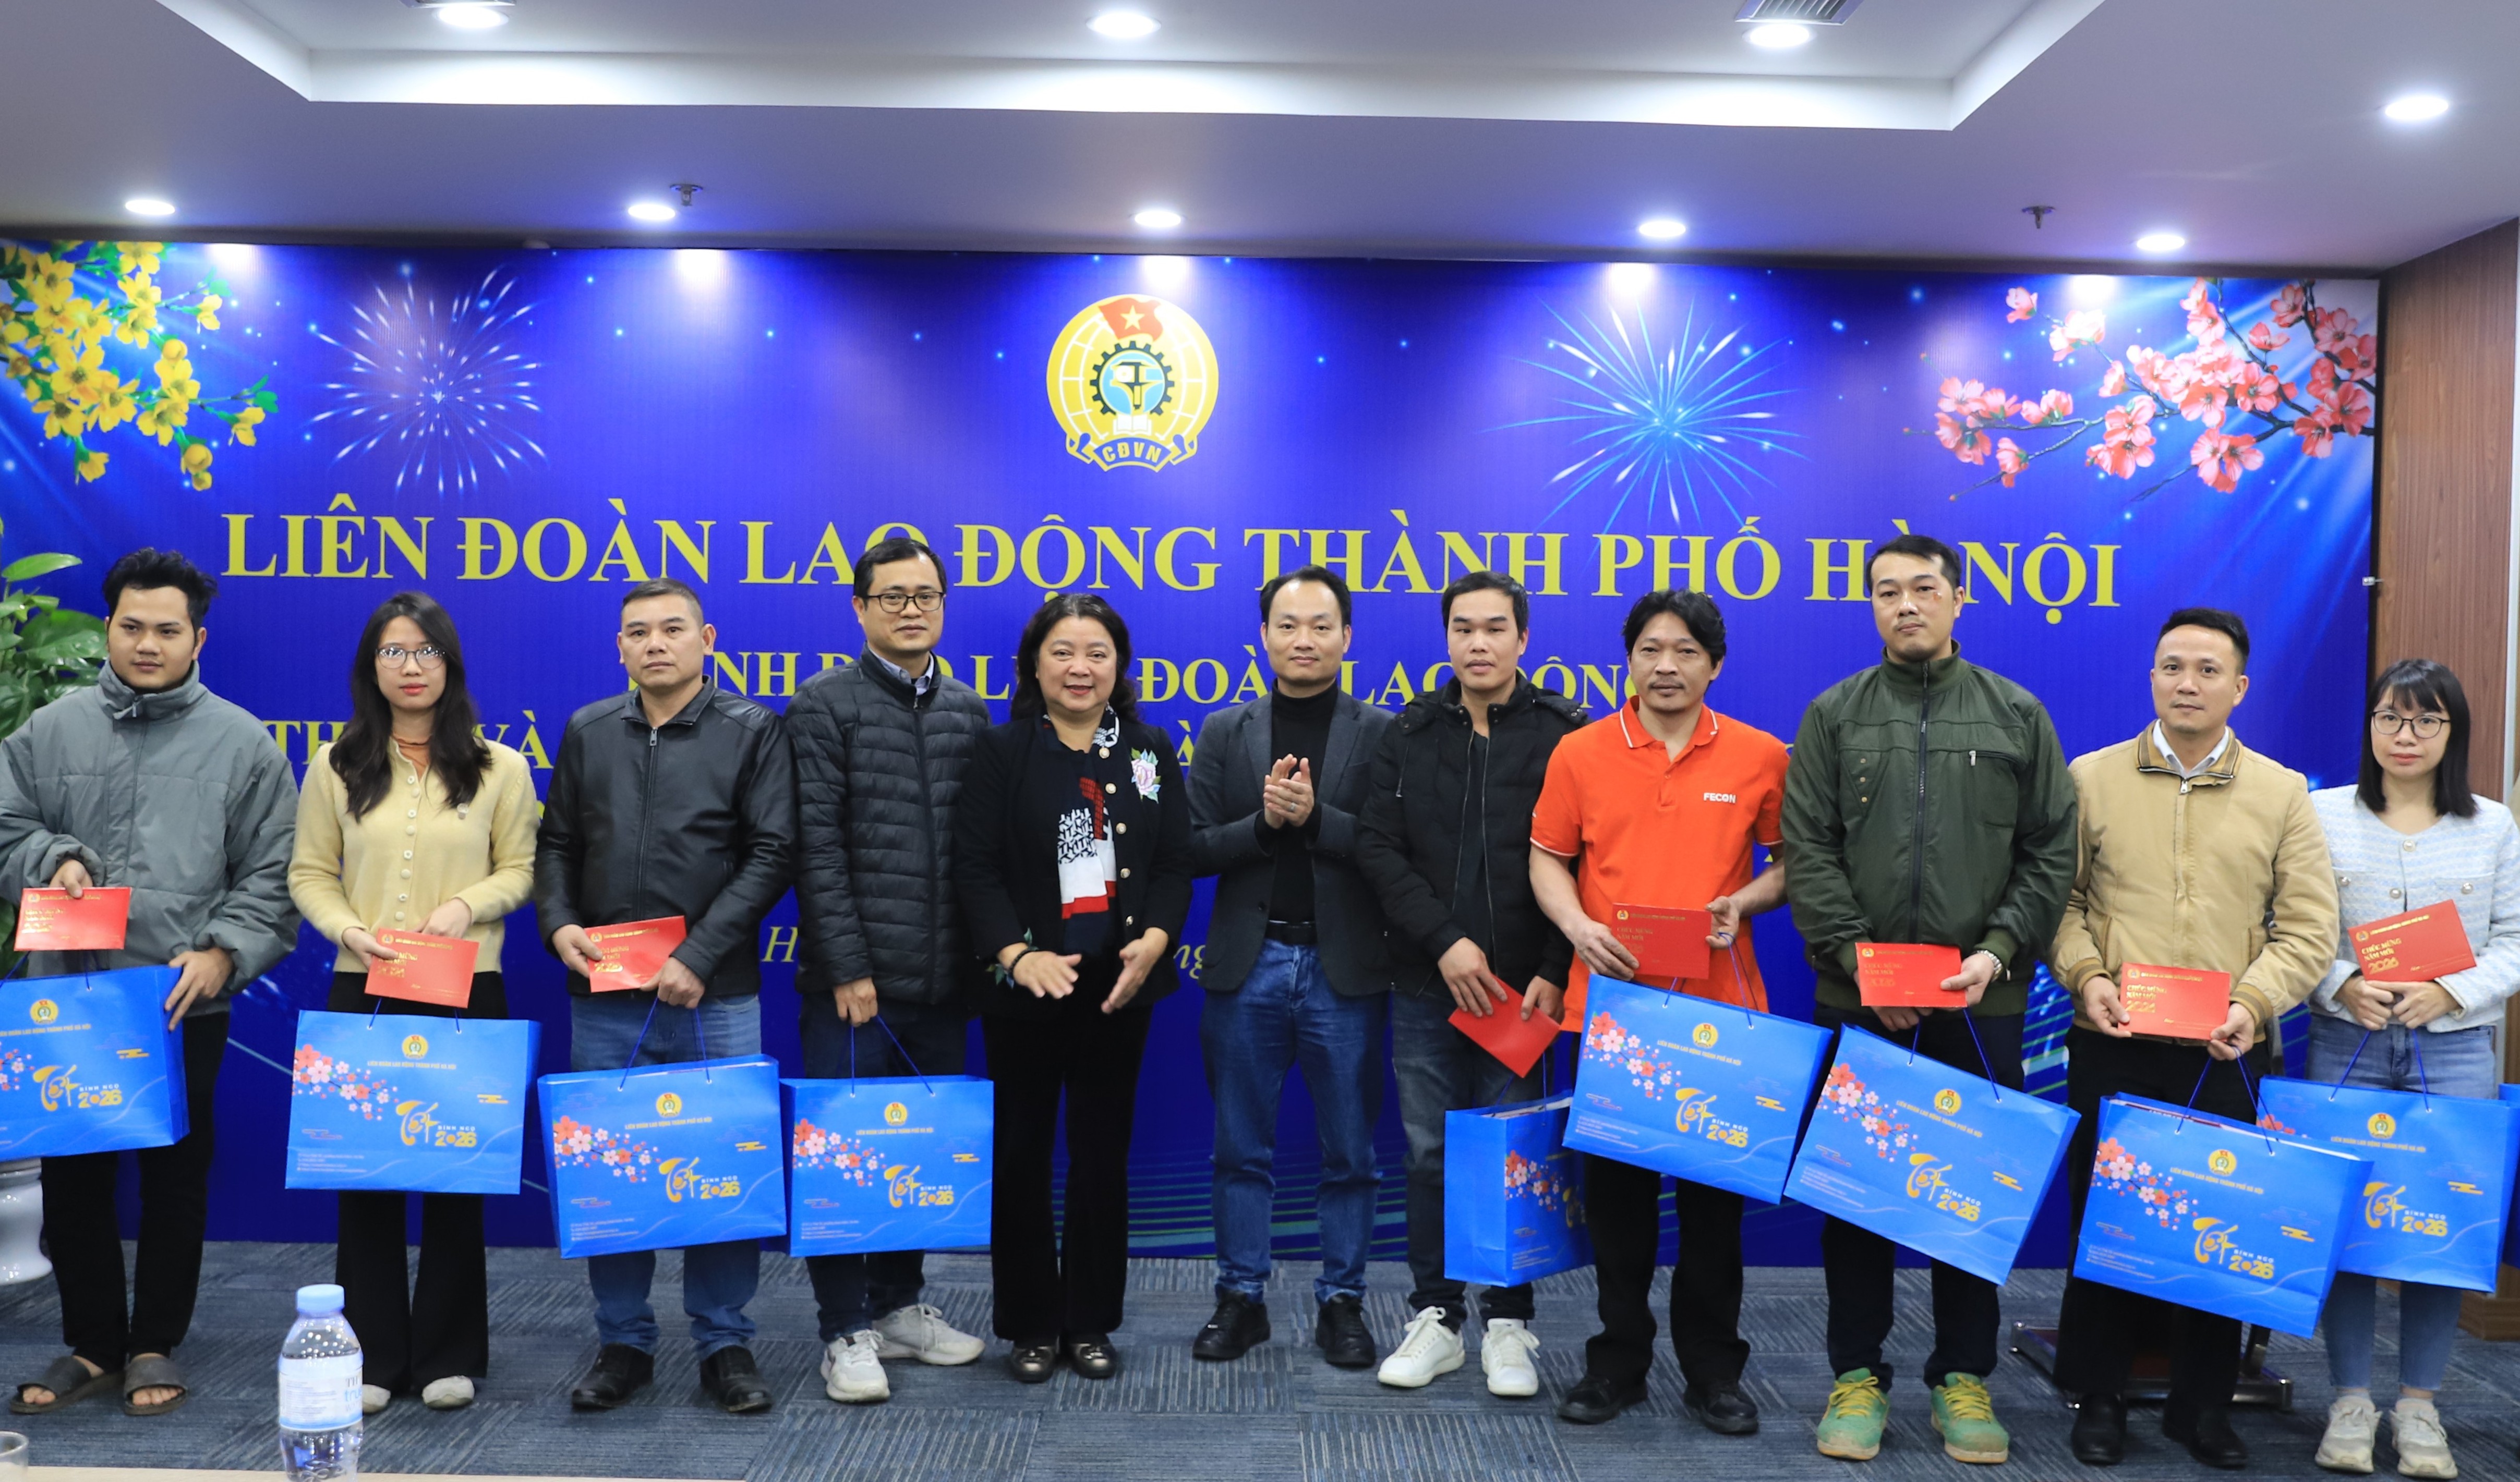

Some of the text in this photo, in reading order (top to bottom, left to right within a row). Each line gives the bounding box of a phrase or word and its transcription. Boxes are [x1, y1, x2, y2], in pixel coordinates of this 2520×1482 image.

[1102, 442, 1162, 464] CĐVN
[221, 493, 435, 580] LIÊN
[456, 498, 717, 585] ĐOÀN
[954, 514, 1222, 603] ĐỘNG
[1244, 509, 1569, 596] THÀNH
[1591, 516, 1781, 601] PHỐ
[1804, 519, 1910, 602] H
[1958, 531, 2121, 625] NỘI
[1136, 645, 1268, 704] ĐOÀ
[1703, 792, 1737, 804] FECON
[78, 1089, 122, 1109] 2026
[435, 1131, 477, 1147] 2026
[1706, 1124, 1749, 1148] 2026
[700, 1181, 741, 1199] 2026
[918, 1190, 954, 1206] 2026
[1937, 1193, 1981, 1222] 2026
[2401, 1216, 2448, 1237] 2026
[2228, 1255, 2274, 1279] 2026
